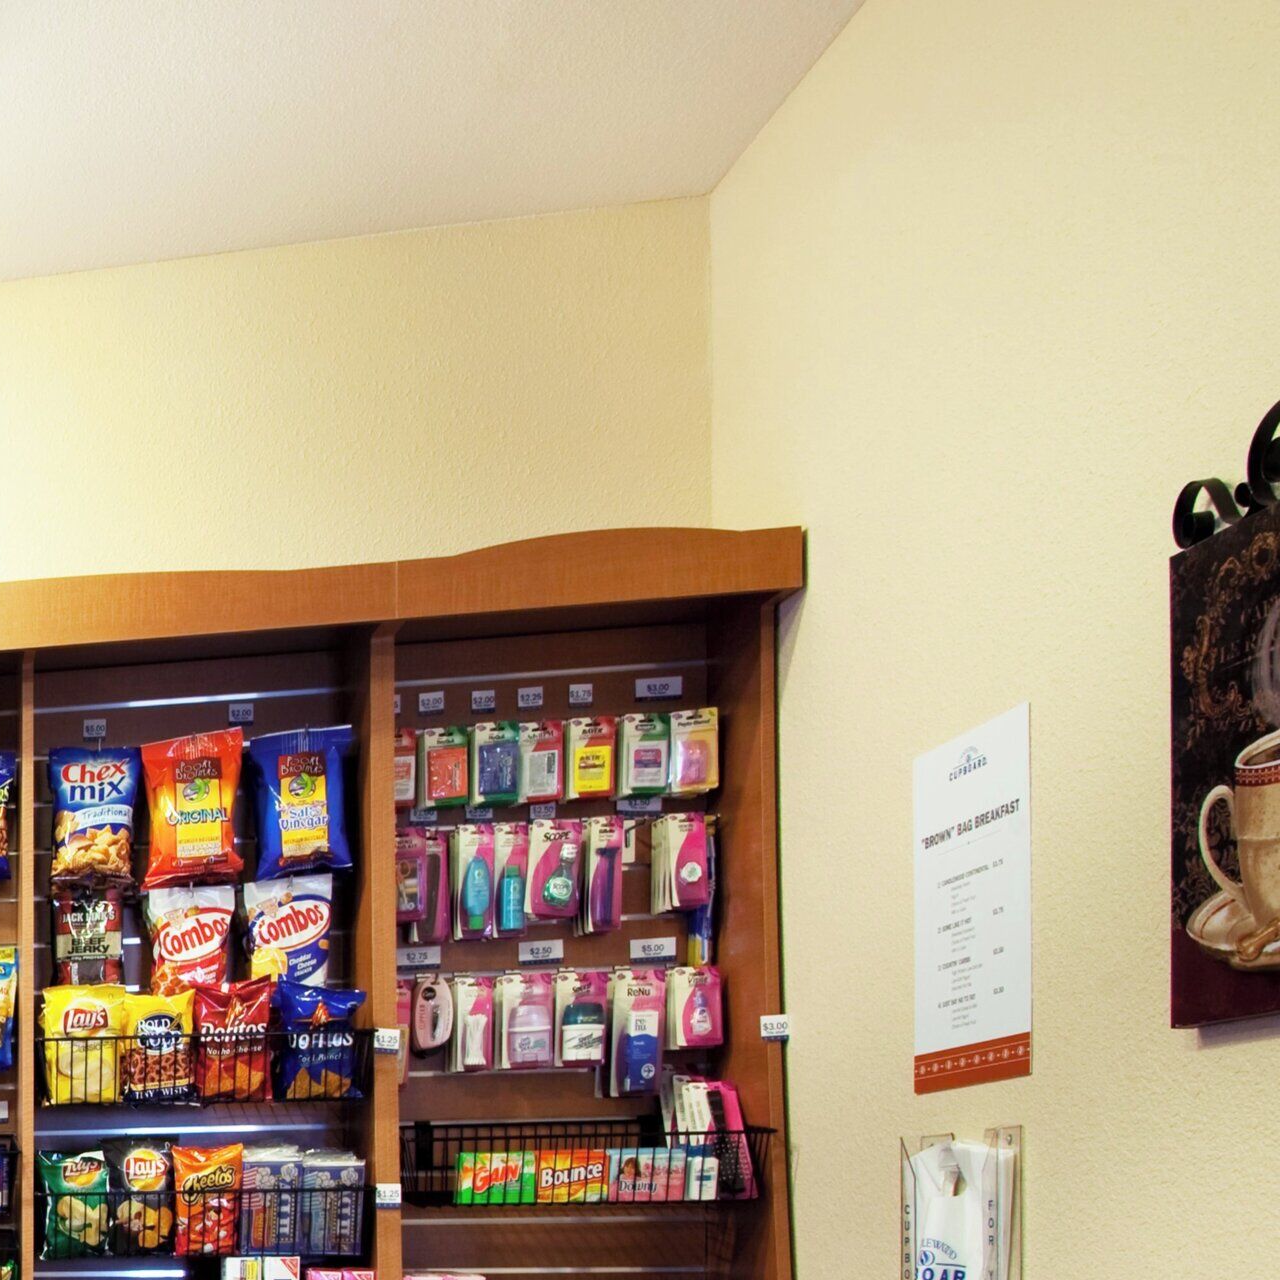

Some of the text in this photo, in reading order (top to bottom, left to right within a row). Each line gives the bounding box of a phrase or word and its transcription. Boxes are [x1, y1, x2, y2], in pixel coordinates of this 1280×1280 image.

[646, 683, 670, 692] $3.00
[60, 757, 128, 785] Chex
[948, 756, 988, 782] CUPBOARD
[68, 774, 126, 803] mix
[81, 806, 131, 820] Traditional
[167, 807, 229, 825] ORIGINAL
[531, 804, 555, 813] $2.50
[278, 814, 330, 831] Vinegar
[957, 818, 973, 837] BAG
[974, 798, 1021, 830] BREAKFAST
[542, 830, 570, 842] SCOPE
[62, 913, 84, 924] JACK
[258, 902, 326, 946] Combos
[71, 936, 106, 946] BEEF
[162, 916, 230, 957] Combos
[67, 944, 110, 955] JERKY
[529, 947, 553, 957] $2.50
[641, 943, 665, 953] $5.00
[405, 952, 429, 962] $2.75
[626, 987, 651, 998] ReNu
[66, 1006, 107, 1033] Lay's
[137, 1018, 171, 1032] ROLD
[762, 1021, 789, 1032] $3.00
[199, 1021, 268, 1044] Doritos
[375, 1034, 399, 1044] $1.25
[128, 1157, 165, 1180] Lay's
[540, 1161, 604, 1186] Bounce
[182, 1165, 235, 1203] Cheetos
[472, 1162, 521, 1193] GAIN
[618, 1178, 658, 1194] Downy
[377, 1189, 400, 1199] $1.25
